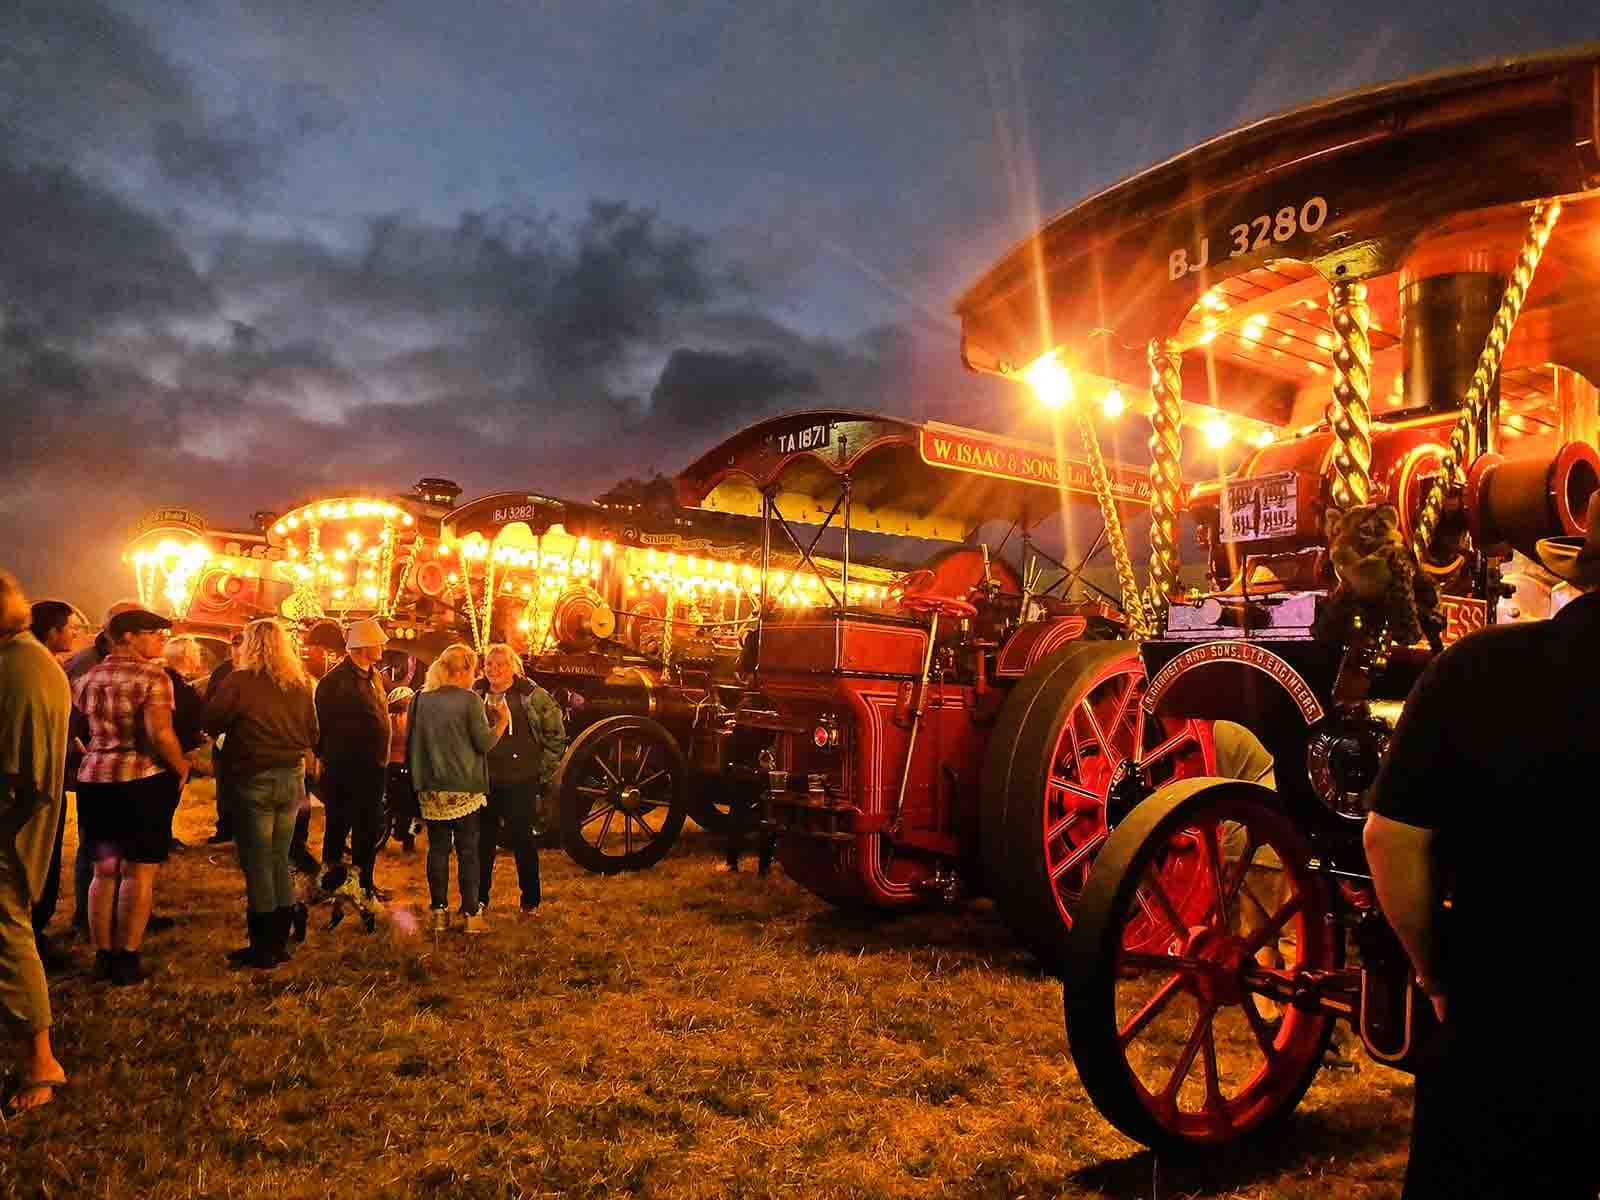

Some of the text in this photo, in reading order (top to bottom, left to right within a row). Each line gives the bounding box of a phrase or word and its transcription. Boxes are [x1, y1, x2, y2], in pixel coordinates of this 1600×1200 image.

[1168, 197, 1328, 281] BJ 3280
[779, 425, 825, 453] TA 1871
[495, 508, 508, 521] BJ
[1185, 647, 1206, 666] AND
